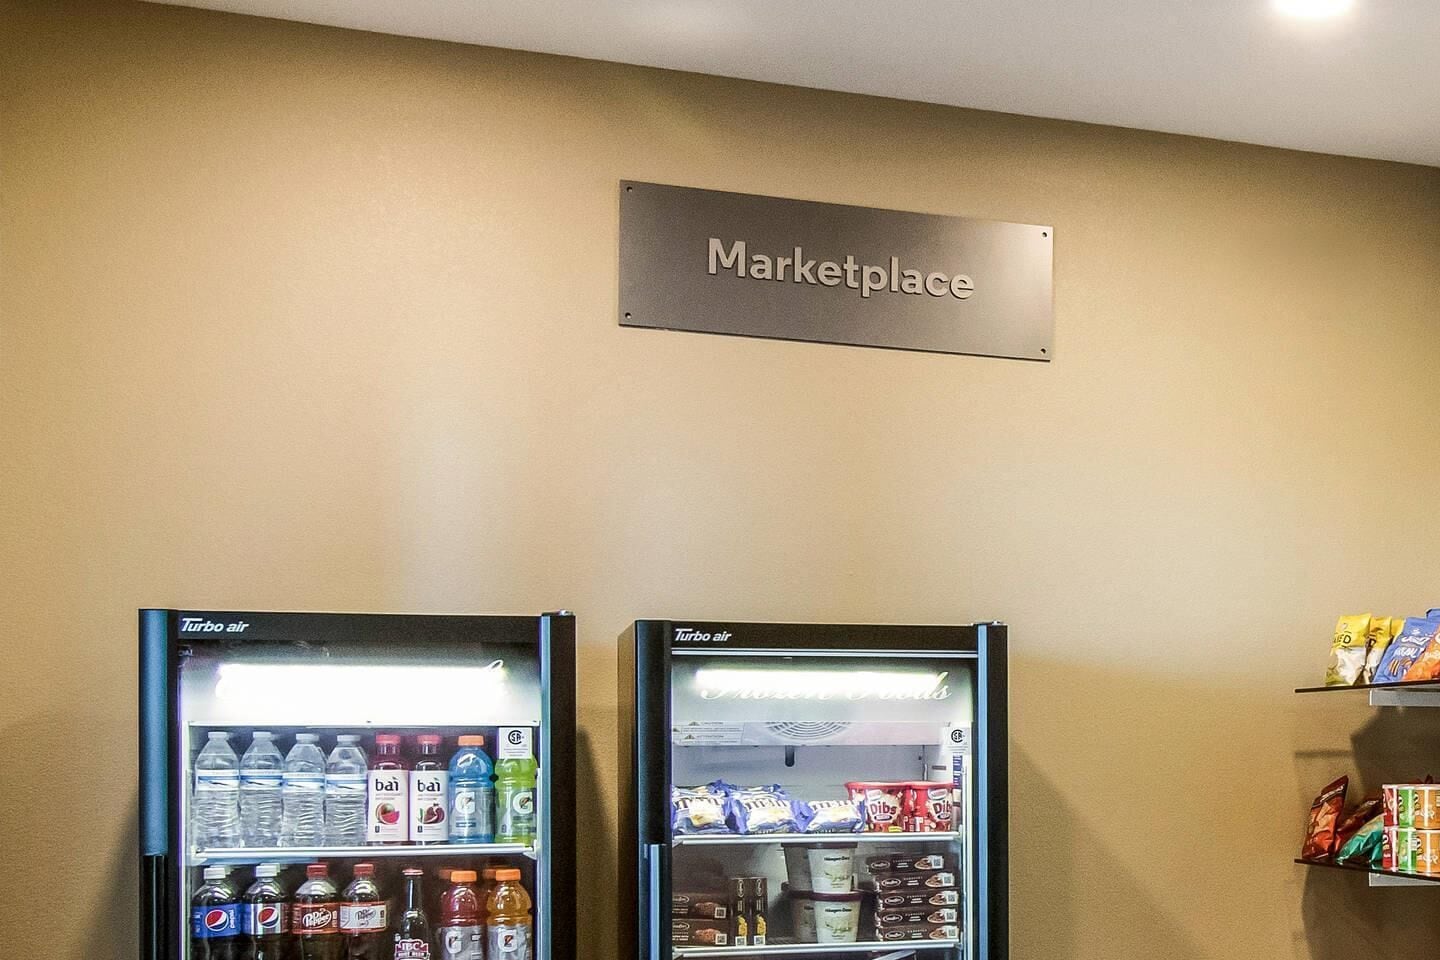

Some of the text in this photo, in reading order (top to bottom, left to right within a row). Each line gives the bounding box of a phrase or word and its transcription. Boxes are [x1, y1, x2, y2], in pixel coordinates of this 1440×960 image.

[707, 237, 975, 300] Marketplace
[181, 617, 249, 632] Turbo air
[675, 628, 732, 641] Turbo air
[375, 776, 399, 792] bai
[417, 777, 441, 792] bai
[869, 801, 897, 816] Dibs
[933, 800, 951, 815] Dib
[402, 942, 420, 951] IBC
